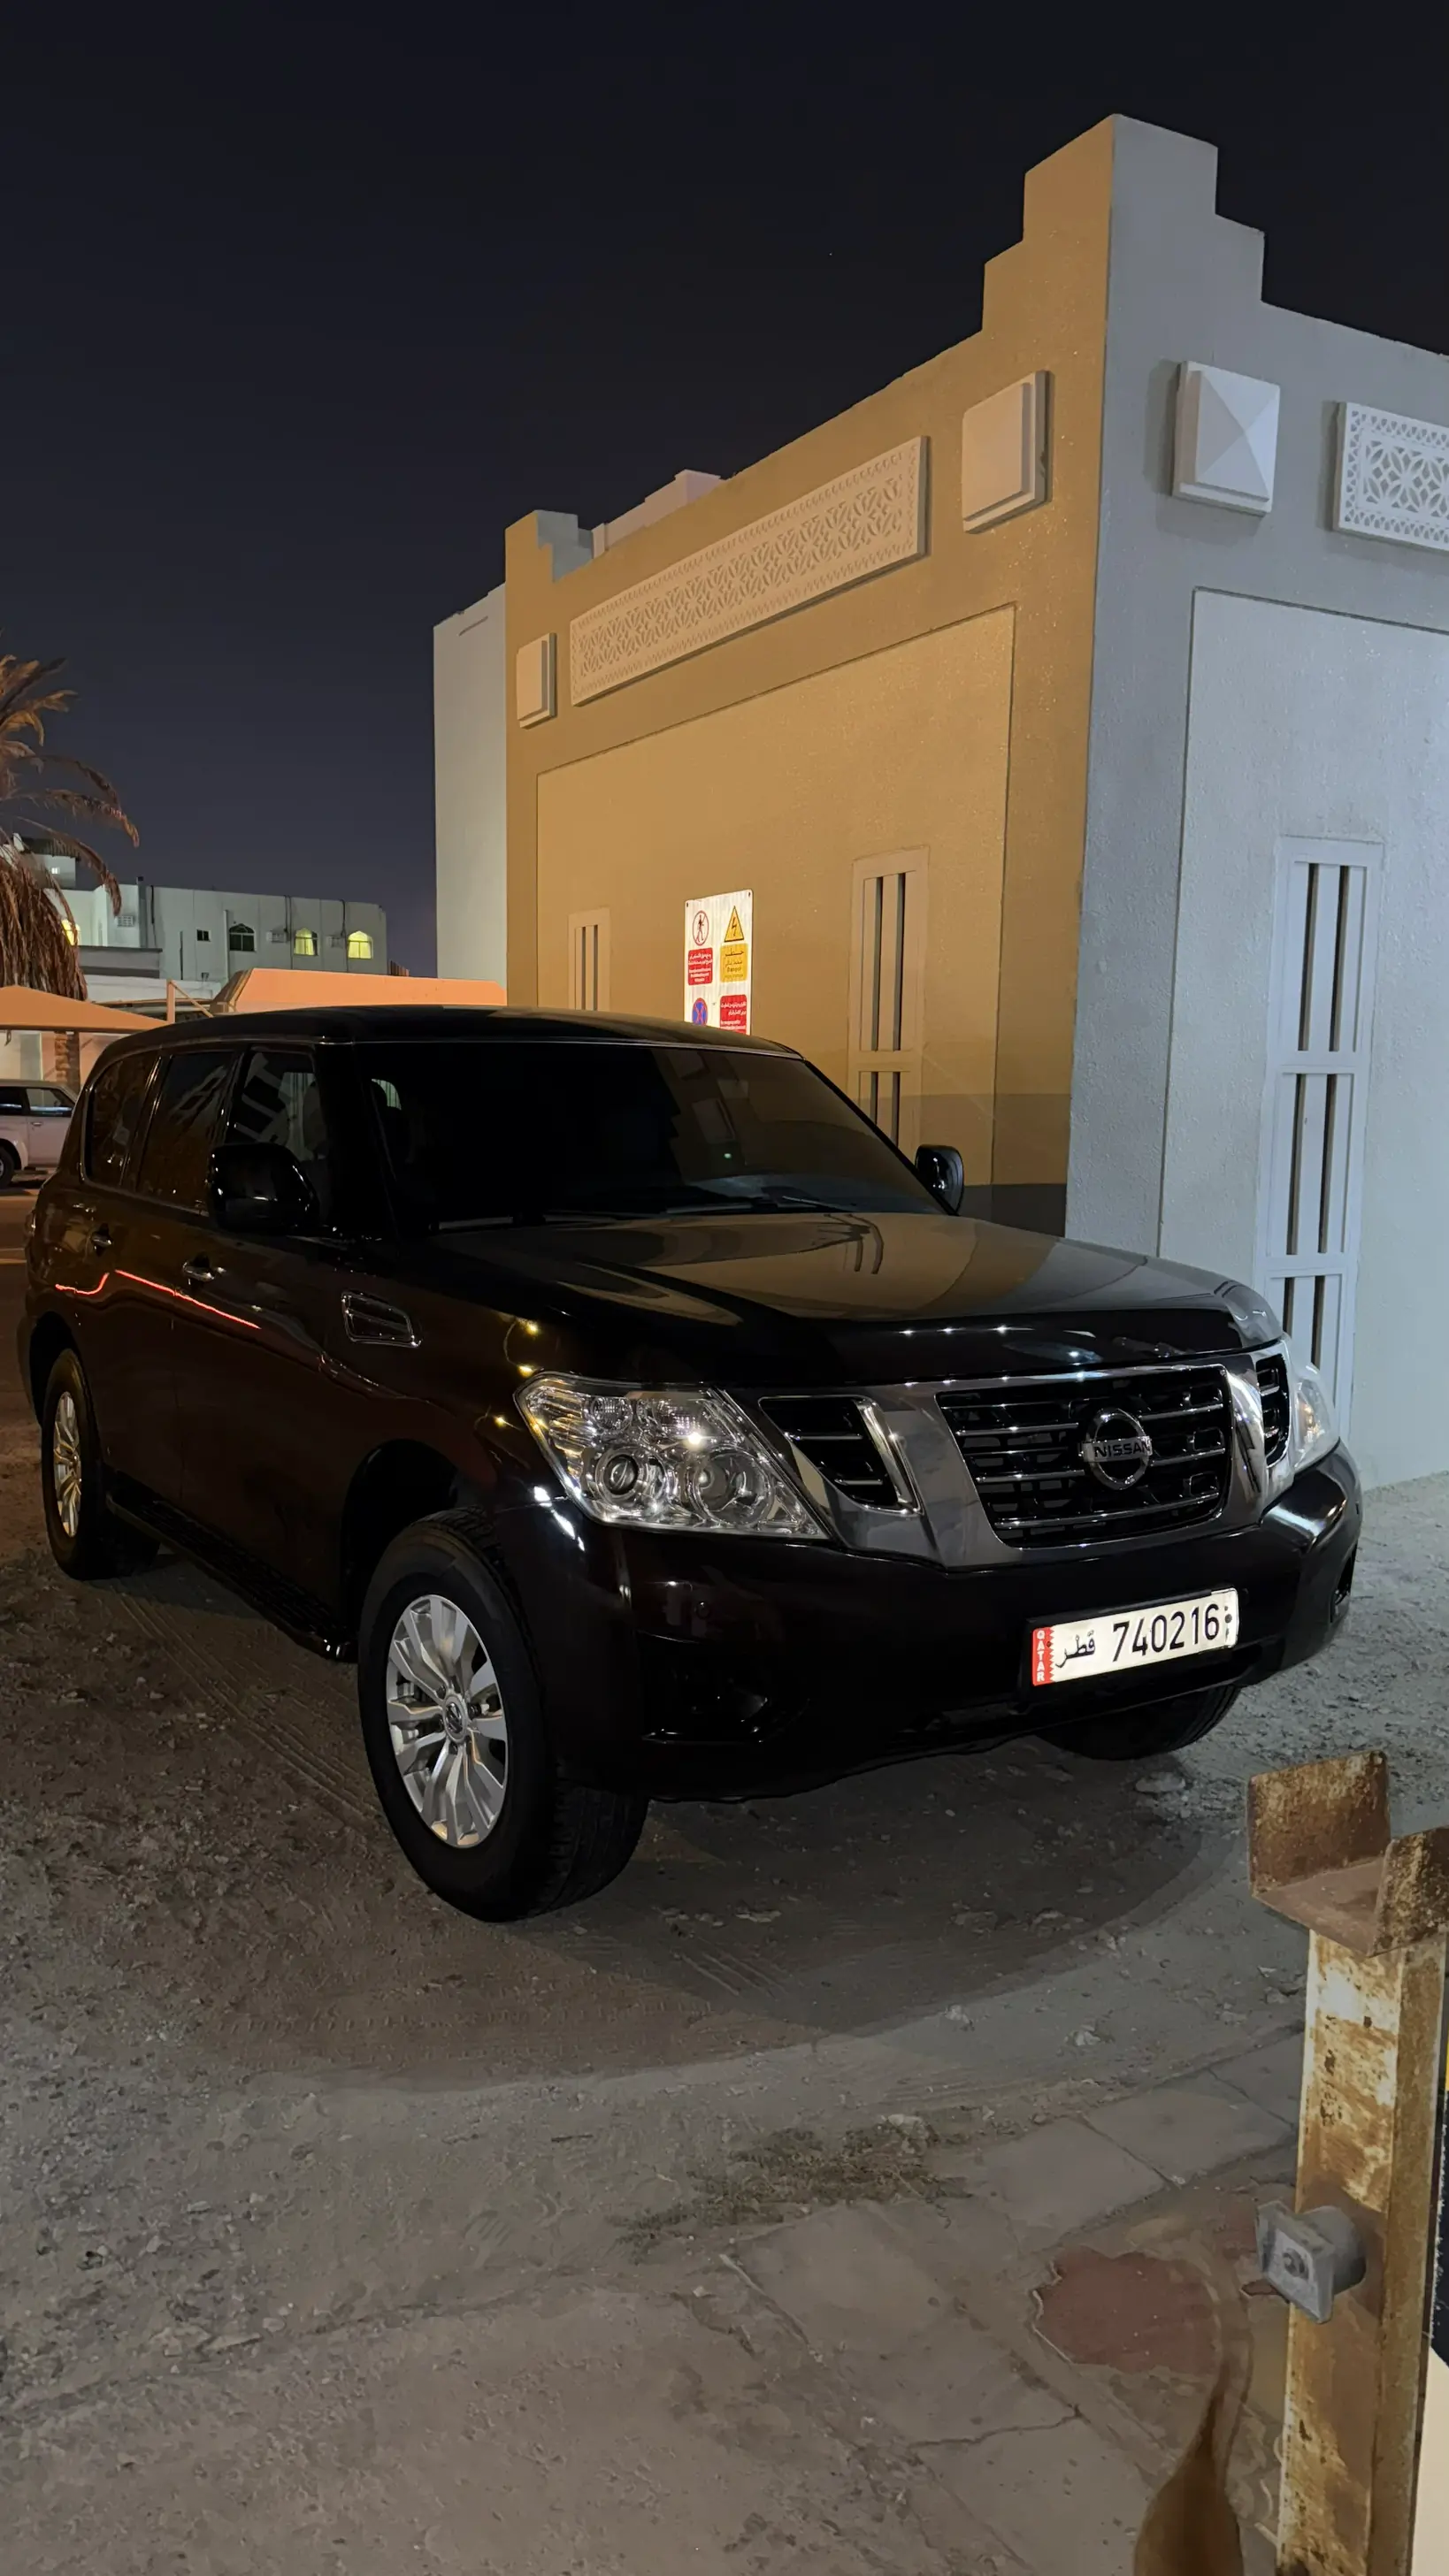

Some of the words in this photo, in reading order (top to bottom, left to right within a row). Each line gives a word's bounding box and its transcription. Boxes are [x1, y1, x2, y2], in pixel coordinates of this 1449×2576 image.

[1095, 1440, 1151, 1457] NISSAN
[1055, 1630, 1096, 1669] قطر
[1111, 1603, 1220, 1663] 740216
[1036, 1630, 1046, 1682] QATAR
